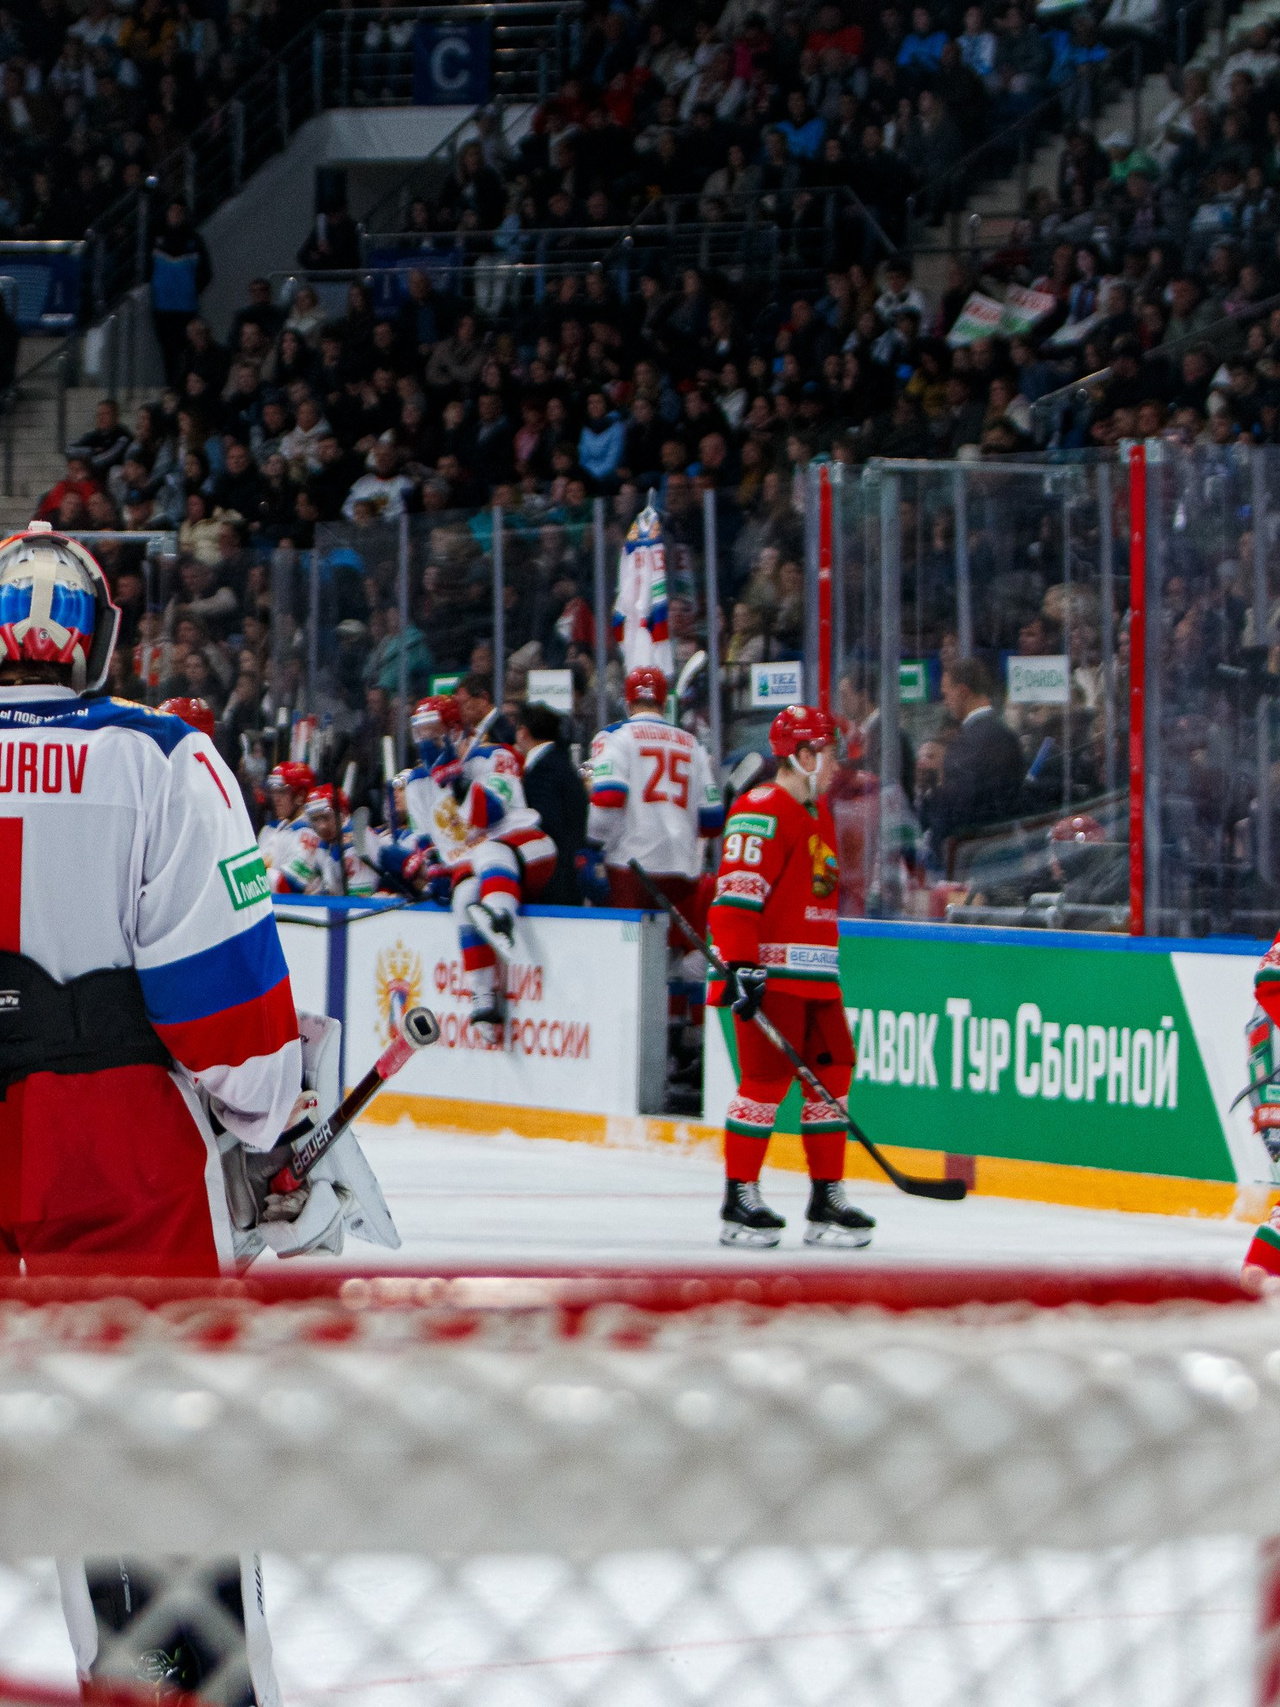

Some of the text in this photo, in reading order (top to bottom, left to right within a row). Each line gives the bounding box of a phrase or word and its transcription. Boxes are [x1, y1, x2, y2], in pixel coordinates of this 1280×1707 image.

[194, 752, 232, 808] 1
[639, 746, 692, 810] 25
[724, 833, 764, 866] 96
[510, 1017, 591, 1060] РОССИИ
[844, 996, 1179, 1109] ТАВОК ТУР СБОРНОЙ
